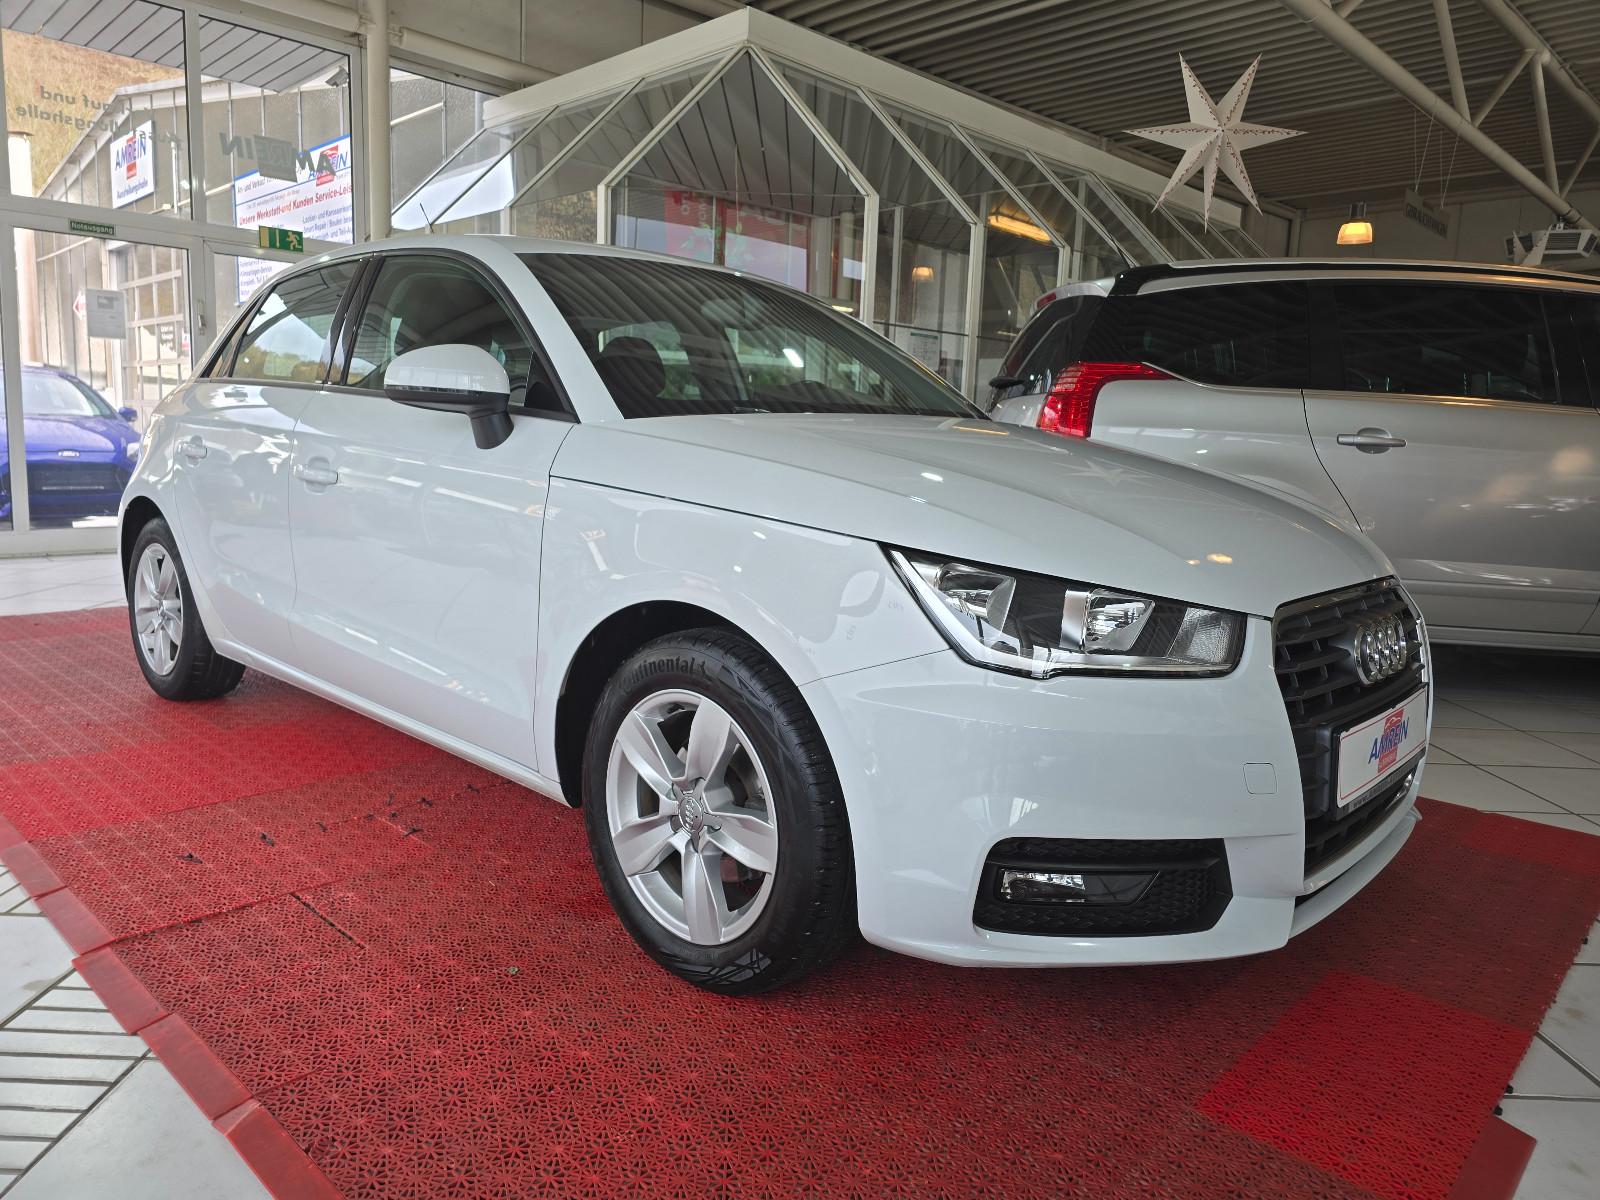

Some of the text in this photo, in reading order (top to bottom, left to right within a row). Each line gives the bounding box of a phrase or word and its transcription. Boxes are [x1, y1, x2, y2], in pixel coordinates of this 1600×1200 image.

[115, 137, 147, 171] AMREIN
[239, 213, 257, 226] Unsere
[292, 195, 314, 210] Kunden
[71, 222, 113, 235] Notausgang
[1368, 716, 1410, 764] AMREIN
